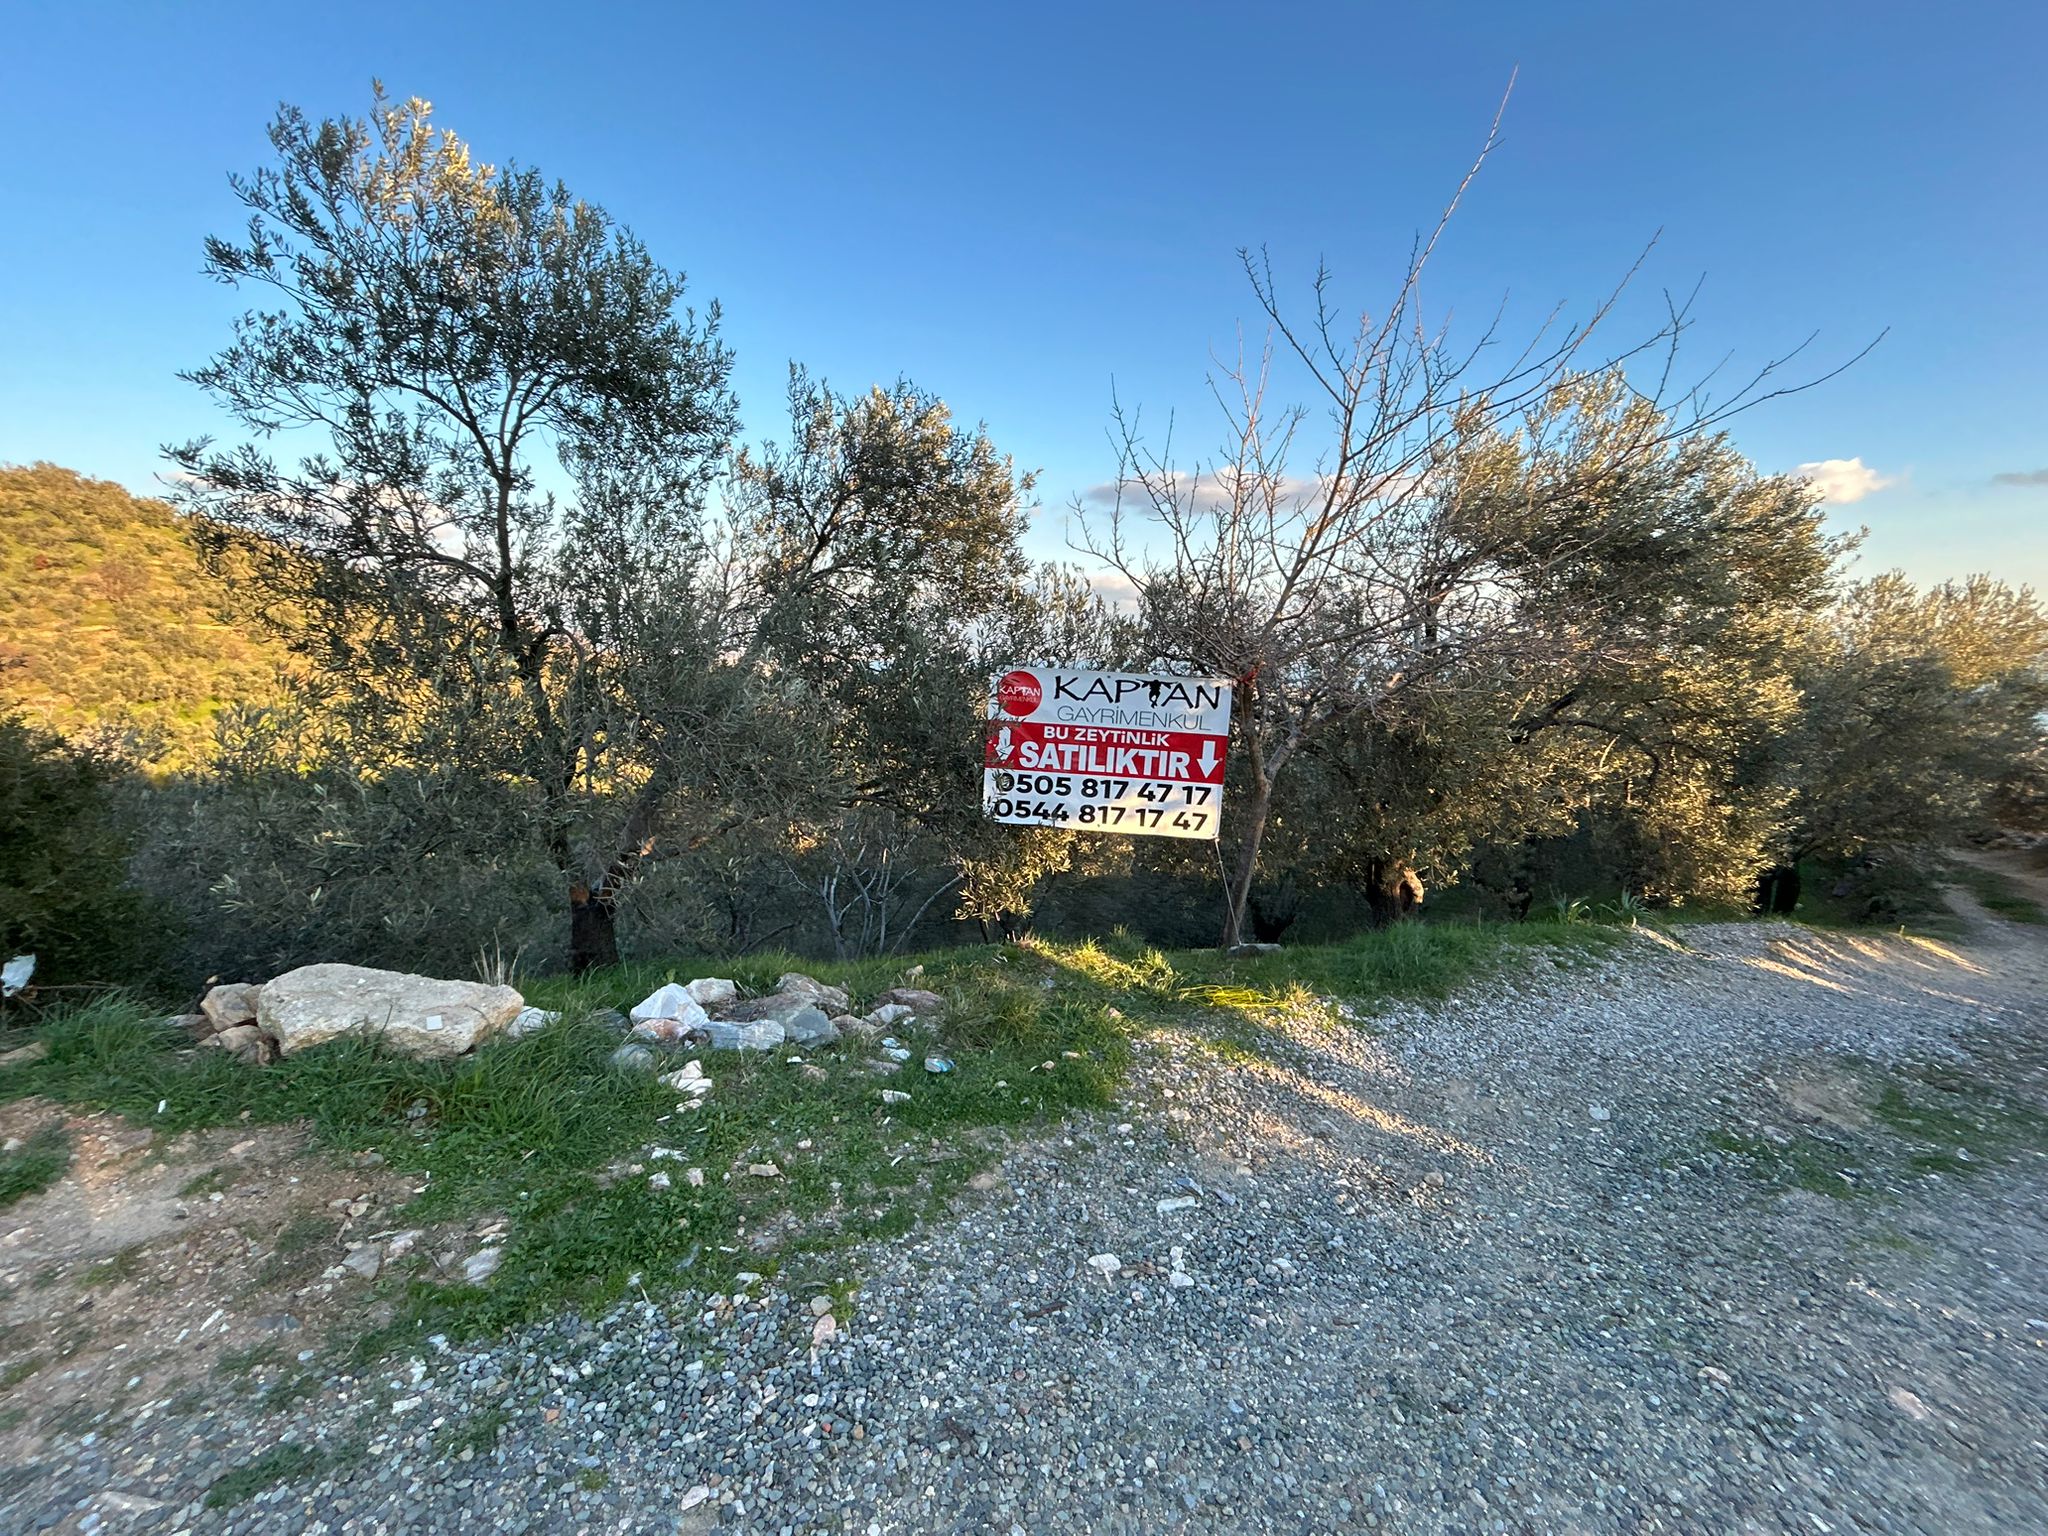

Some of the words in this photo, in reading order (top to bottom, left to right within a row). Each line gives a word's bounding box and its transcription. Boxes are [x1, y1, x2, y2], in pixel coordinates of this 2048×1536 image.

[1000, 686, 1041, 696] KAPTAN
[1053, 675, 1221, 710] KAPTAN
[1043, 725, 1070, 741] BU
[1057, 705, 1212, 732] GAYRİMENKUL
[1018, 741, 1190, 779] SATILIKTIR
[998, 772, 1072, 796] 0505
[1081, 778, 1129, 800] 817
[1137, 782, 1173, 803] 47
[1182, 785, 1211, 806] 17
[996, 798, 1069, 822] 0544
[1078, 804, 1127, 826] 817
[1135, 808, 1165, 829] 17
[1172, 811, 1208, 832] 47
